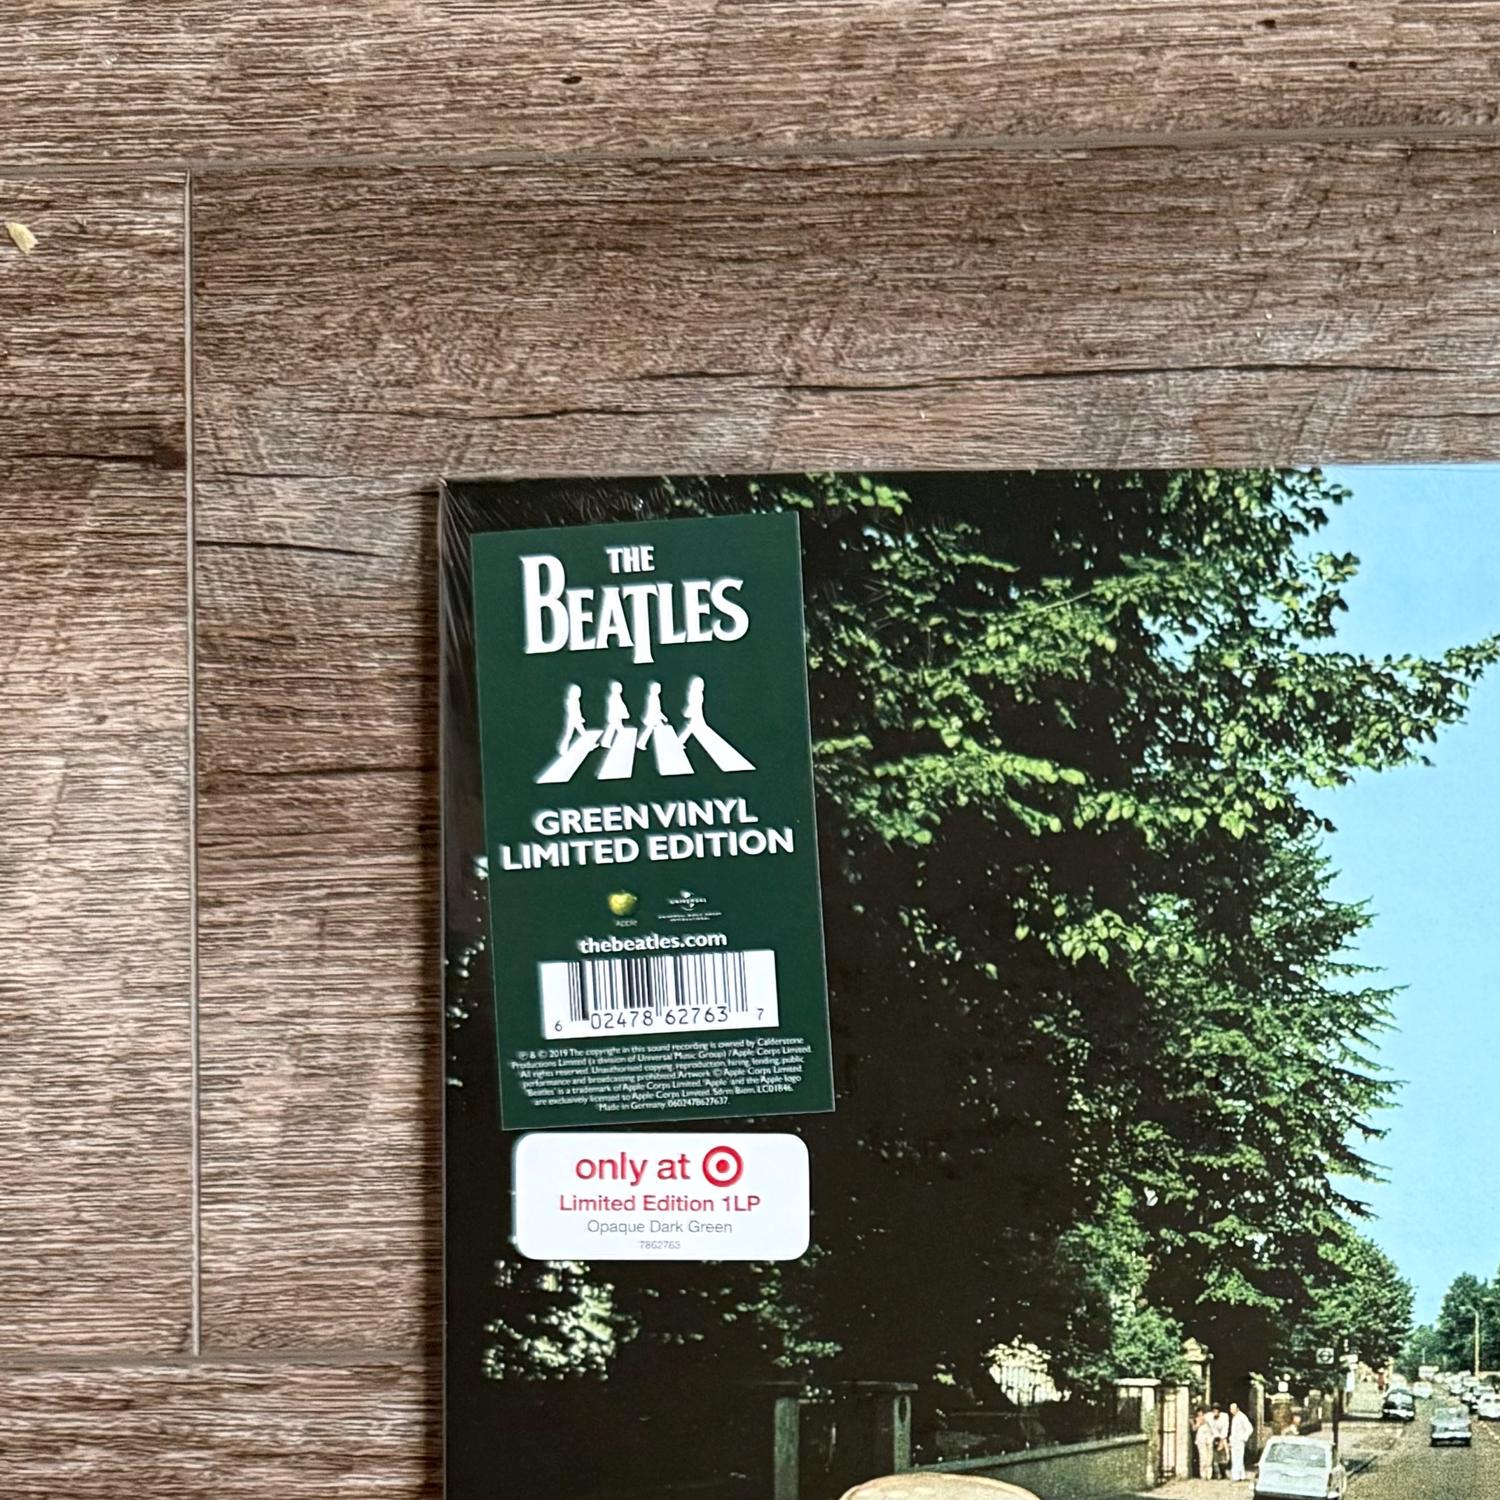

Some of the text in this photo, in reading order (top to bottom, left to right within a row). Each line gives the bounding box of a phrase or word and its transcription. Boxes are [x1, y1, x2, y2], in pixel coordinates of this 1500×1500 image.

[606, 545, 655, 574] THE
[520, 553, 749, 664] BEATLES
[533, 797, 758, 836] GREEN VINYL
[500, 827, 795, 871] LIMITED EDITION
[579, 932, 727, 953] thebeatles.com
[554, 1006, 764, 1032] 6 02478 62763 7
[549, 1049, 568, 1058] 2019
[569, 1048, 584, 1057] The
[585, 1046, 621, 1058] copyright
[631, 1045, 645, 1053] this
[647, 1044, 670, 1053] sound
[672, 1041, 709, 1053] recording
[637, 1053, 673, 1063] Universal
[674, 1051, 696, 1060] Music
[756, 1047, 781, 1058] Corps
[782, 1056, 804, 1066] public
[575, 1152, 691, 1186] only at
[559, 1195, 761, 1212] Limited Edition 1LP
[587, 1220, 733, 1236] Opaque Dark Green
